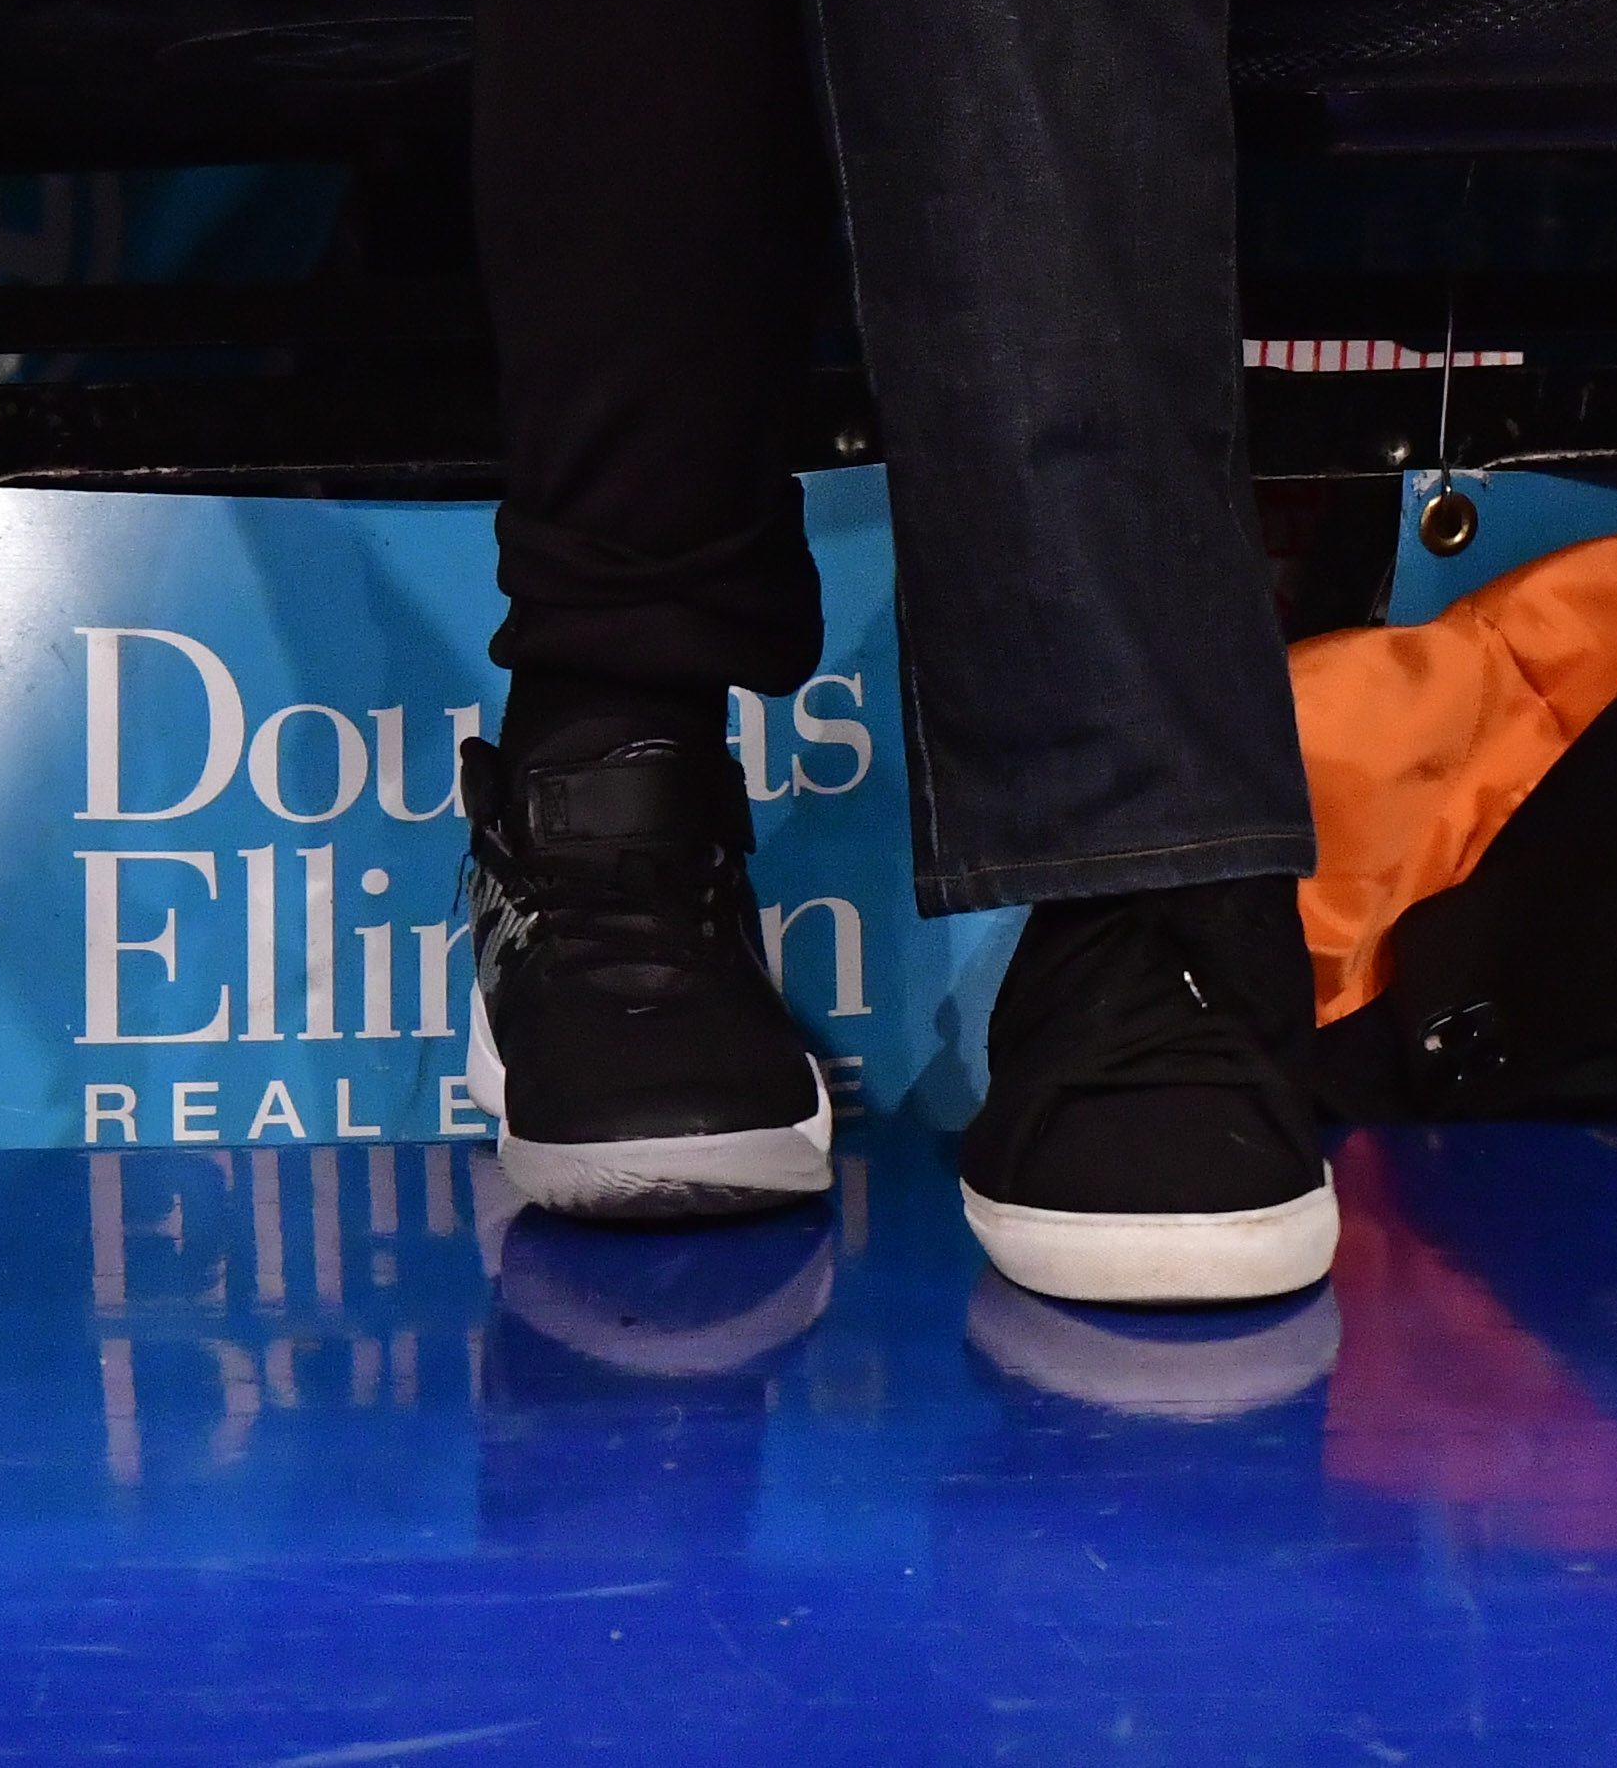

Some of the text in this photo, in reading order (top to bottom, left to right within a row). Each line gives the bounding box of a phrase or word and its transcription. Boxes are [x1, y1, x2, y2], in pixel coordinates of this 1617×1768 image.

[74, 626, 873, 823] Douas
[73, 842, 872, 1045] Ellin
[84, 1078, 382, 1143] REAL
